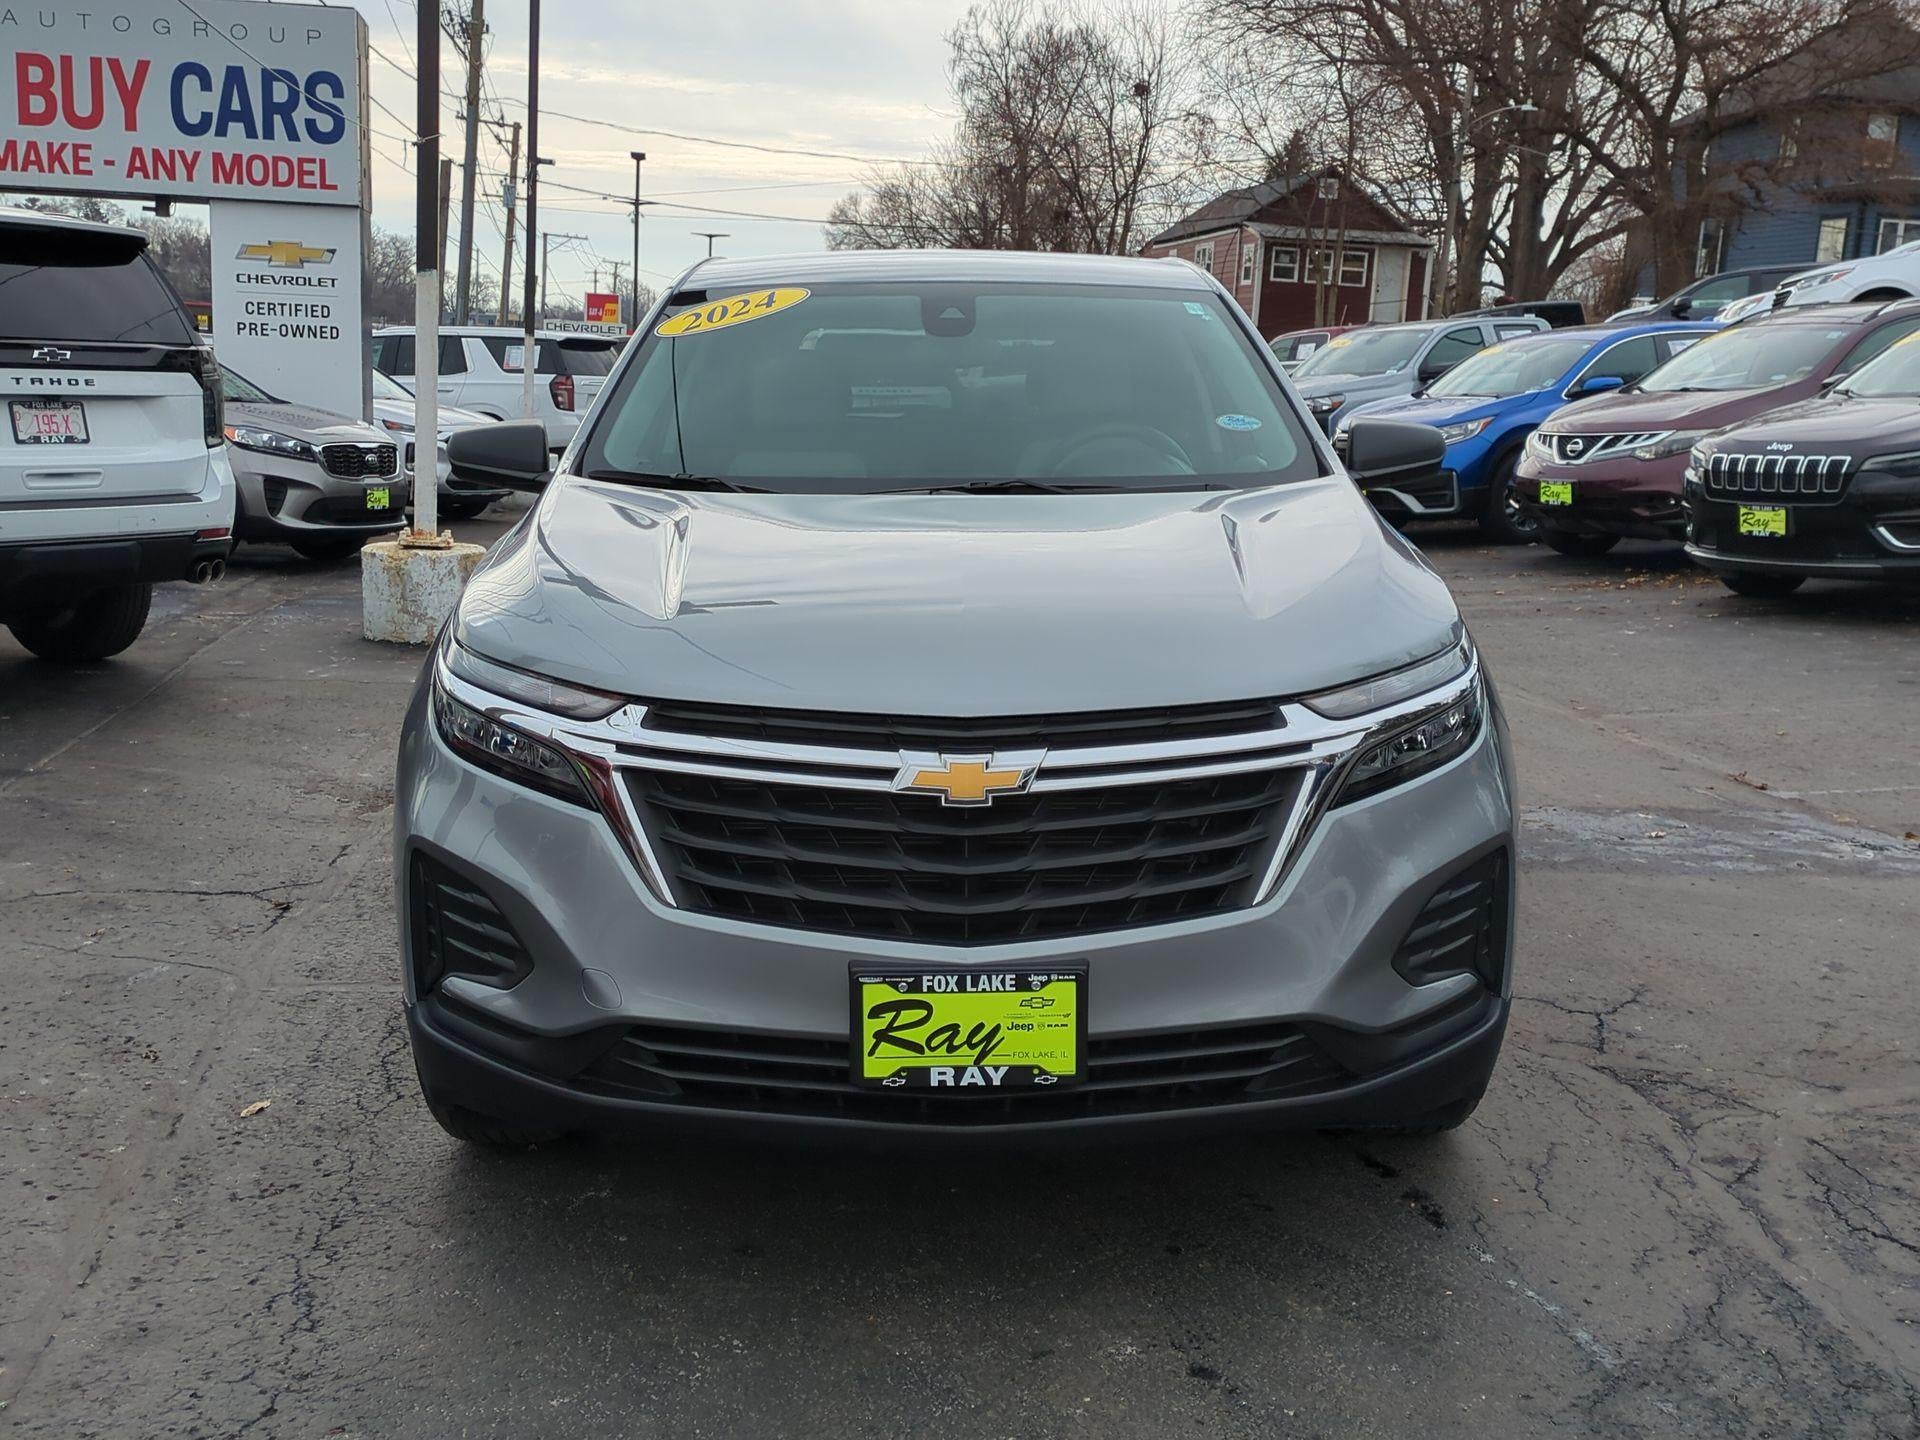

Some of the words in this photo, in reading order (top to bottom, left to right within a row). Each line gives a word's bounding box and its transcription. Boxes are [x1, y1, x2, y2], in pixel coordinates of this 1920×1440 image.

[15, 51, 152, 132] BUY
[170, 61, 346, 145] CARS
[126, 146, 202, 182] ANY
[211, 151, 339, 191] MODEL
[236, 273, 339, 288] CHEVROLET
[245, 301, 331, 319] CERTIFIED
[682, 291, 777, 333] 2024
[236, 321, 340, 340] PRE-OWNED
[546, 321, 625, 335] CHEVROLET
[10, 377, 96, 387] TAHOE
[34, 414, 60, 434] 195
[40, 435, 67, 443] RAY
[1766, 442, 1794, 452] Jeep
[1741, 512, 1770, 531] Ray
[922, 975, 959, 993] FOX
[966, 974, 1016, 992] LAKE
[1028, 974, 1048, 983] Jeep
[867, 998, 1005, 1066] Ray
[1006, 1022, 1034, 1032] Jeep
[1012, 1051, 1030, 1059] FOX
[1032, 1051, 1058, 1059] LAKE,
[930, 1066, 1010, 1087] RAY
